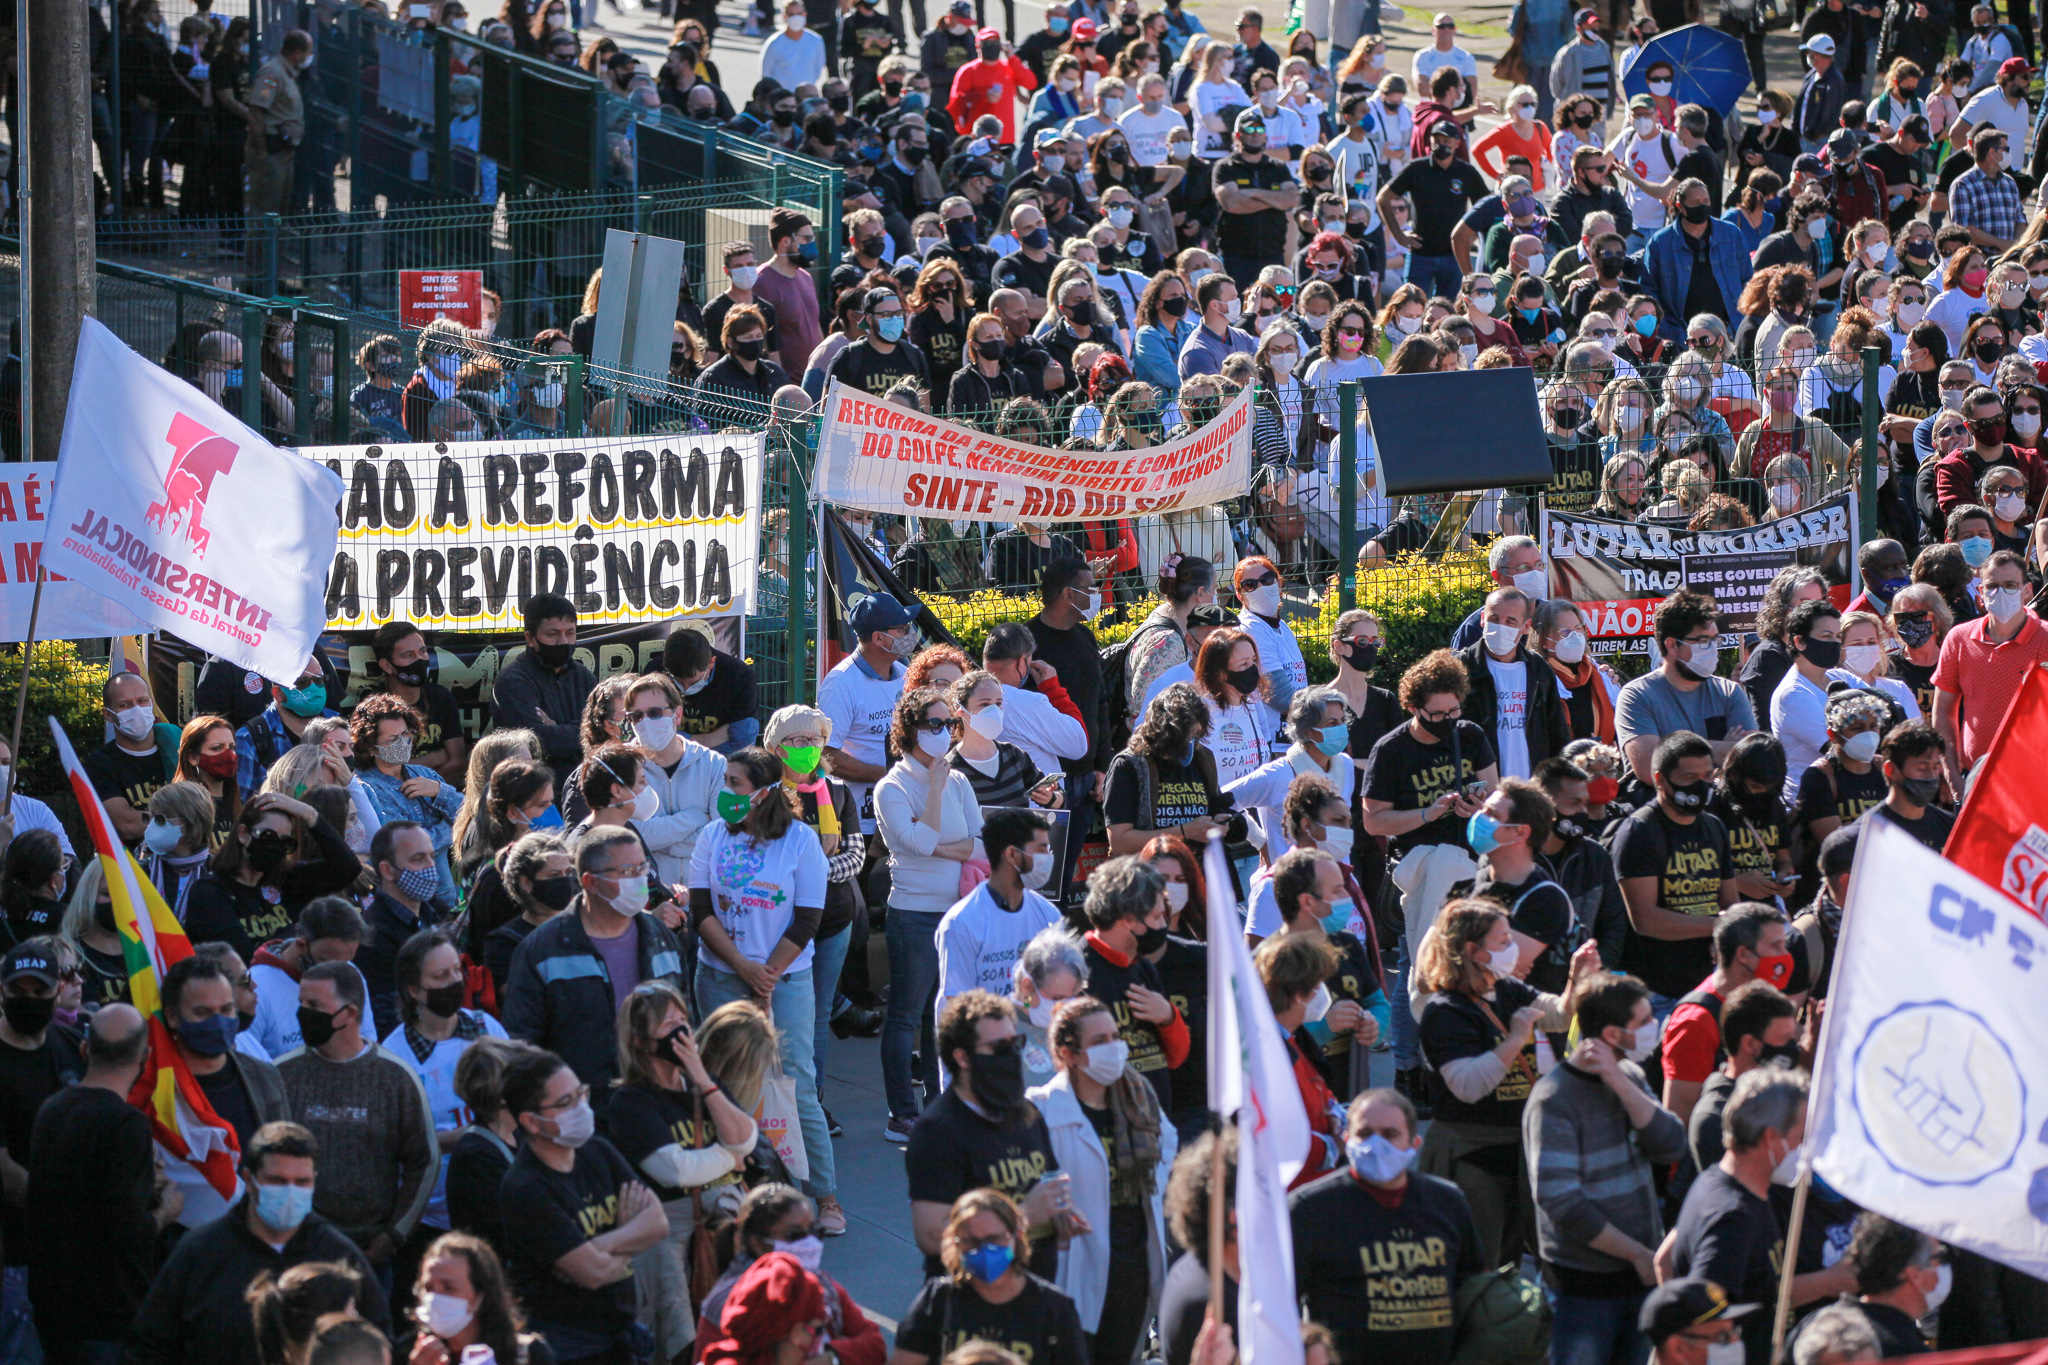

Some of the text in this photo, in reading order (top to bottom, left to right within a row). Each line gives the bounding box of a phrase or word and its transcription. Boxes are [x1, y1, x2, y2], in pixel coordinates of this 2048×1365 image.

[421, 276, 459, 284] SINTE/SC
[837, 397, 939, 437] REFORMA
[940, 429, 973, 447] DA
[973, 439, 1119, 475] PREVIDÊNCIA
[1120, 456, 1138, 475] É
[1137, 402, 1248, 474] CONTINUIDADE
[861, 432, 893, 458] DO
[897, 437, 962, 470] GOLPE,
[966, 452, 1062, 482] NENHUM
[1059, 471, 1149, 493] DIREITO
[1147, 475, 1165, 491] A
[431, 441, 469, 529] À
[482, 446, 745, 526] REFORMA
[903, 473, 999, 519] SINTE
[1019, 486, 1077, 518] RIO
[1079, 490, 1127, 517] DO
[1129, 490, 1187, 515] SUL
[1551, 521, 1680, 560] LUTAR
[1697, 505, 1849, 554] MORRER
[376, 524, 732, 619] PREVIDÊNCIA
[1688, 571, 1723, 584] ESSE
[1714, 584, 1748, 598] NÃO
[1582, 602, 1643, 637] NÃO
[1192, 781, 1206, 794] DE
[1184, 805, 1205, 815] NÃO
[1666, 848, 1720, 875] LUTAR
[743, 888, 769, 898] SOMOS
[751, 880, 780, 891] JUNTOS
[1664, 877, 1721, 896] MORRER
[741, 897, 776, 910] FORTES
[982, 949, 1015, 963] NOSSOS
[1360, 1236, 1447, 1274] LUTAR
